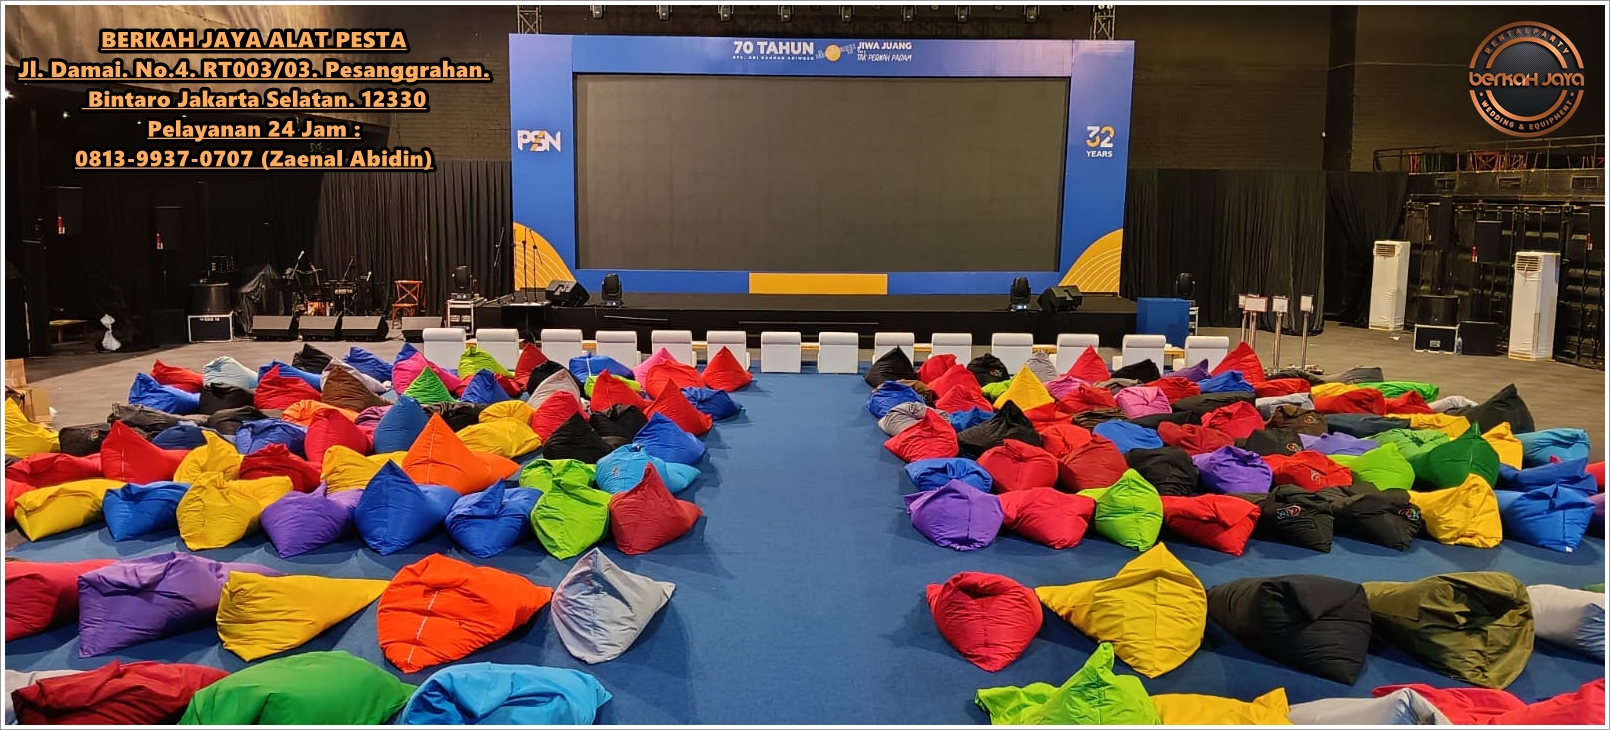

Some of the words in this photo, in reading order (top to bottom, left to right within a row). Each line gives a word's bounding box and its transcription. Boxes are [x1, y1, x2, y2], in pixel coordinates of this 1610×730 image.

[733, 41, 754, 54] 70
[757, 41, 814, 54] TAHUN
[857, 41, 880, 50] JIWA
[881, 41, 912, 50] JUANG
[1086, 126, 1115, 148] 32
[1086, 150, 1113, 158] YEARS
